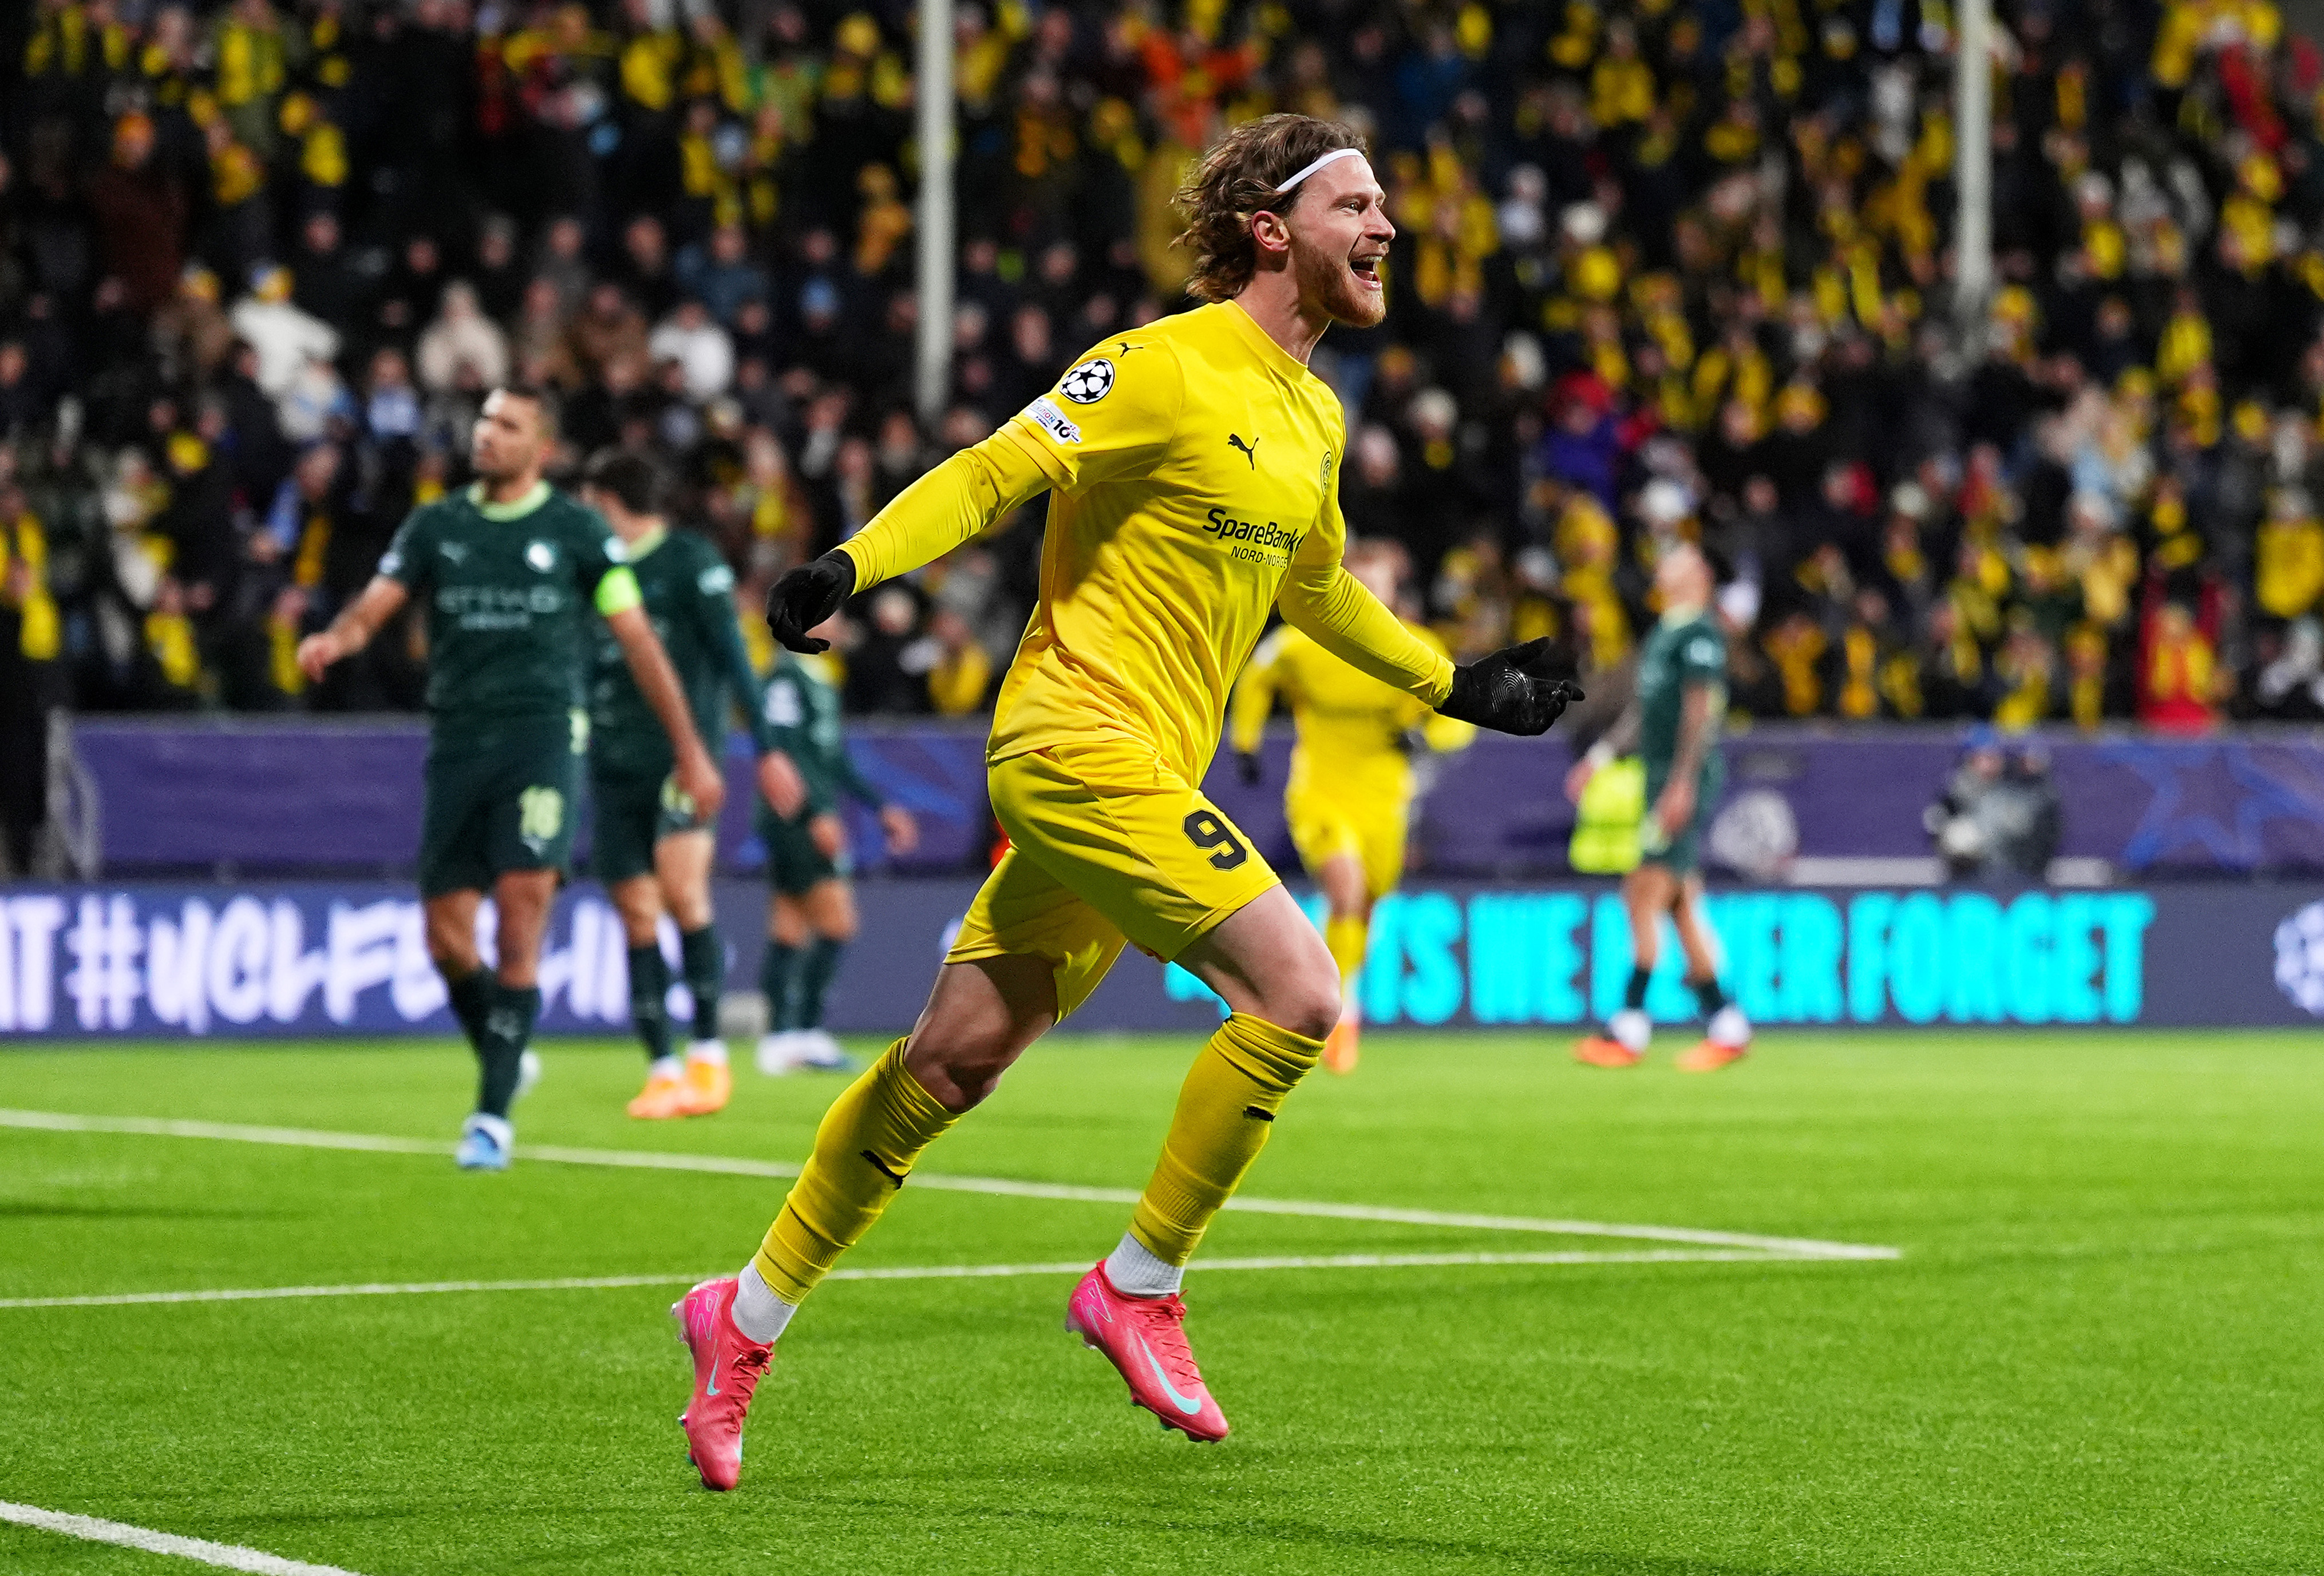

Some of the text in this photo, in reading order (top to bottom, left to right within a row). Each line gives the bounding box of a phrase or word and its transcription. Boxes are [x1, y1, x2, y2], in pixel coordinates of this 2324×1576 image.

[1202, 508, 1300, 553] SpareBank
[1231, 545, 1289, 569] NORD-NORGE
[1181, 808, 1248, 872] 9
[1848, 890, 2156, 1023] FORGET
